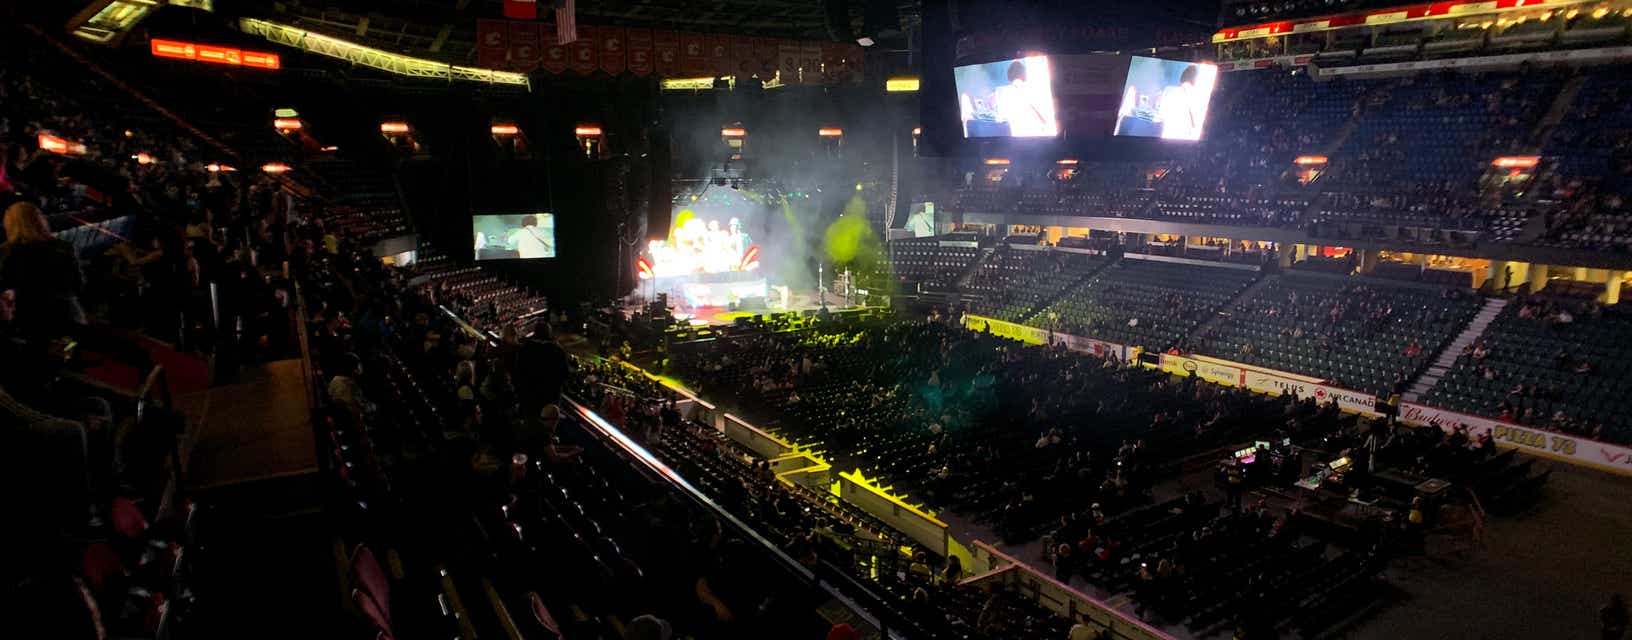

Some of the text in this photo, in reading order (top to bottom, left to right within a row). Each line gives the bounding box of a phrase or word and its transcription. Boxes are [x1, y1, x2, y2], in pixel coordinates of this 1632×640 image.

[1274, 381, 1305, 393] TELUS
[1343, 395, 1374, 407] CANAD
[1400, 404, 1477, 431] Budweir
[1494, 425, 1576, 455] PIZZA 73
